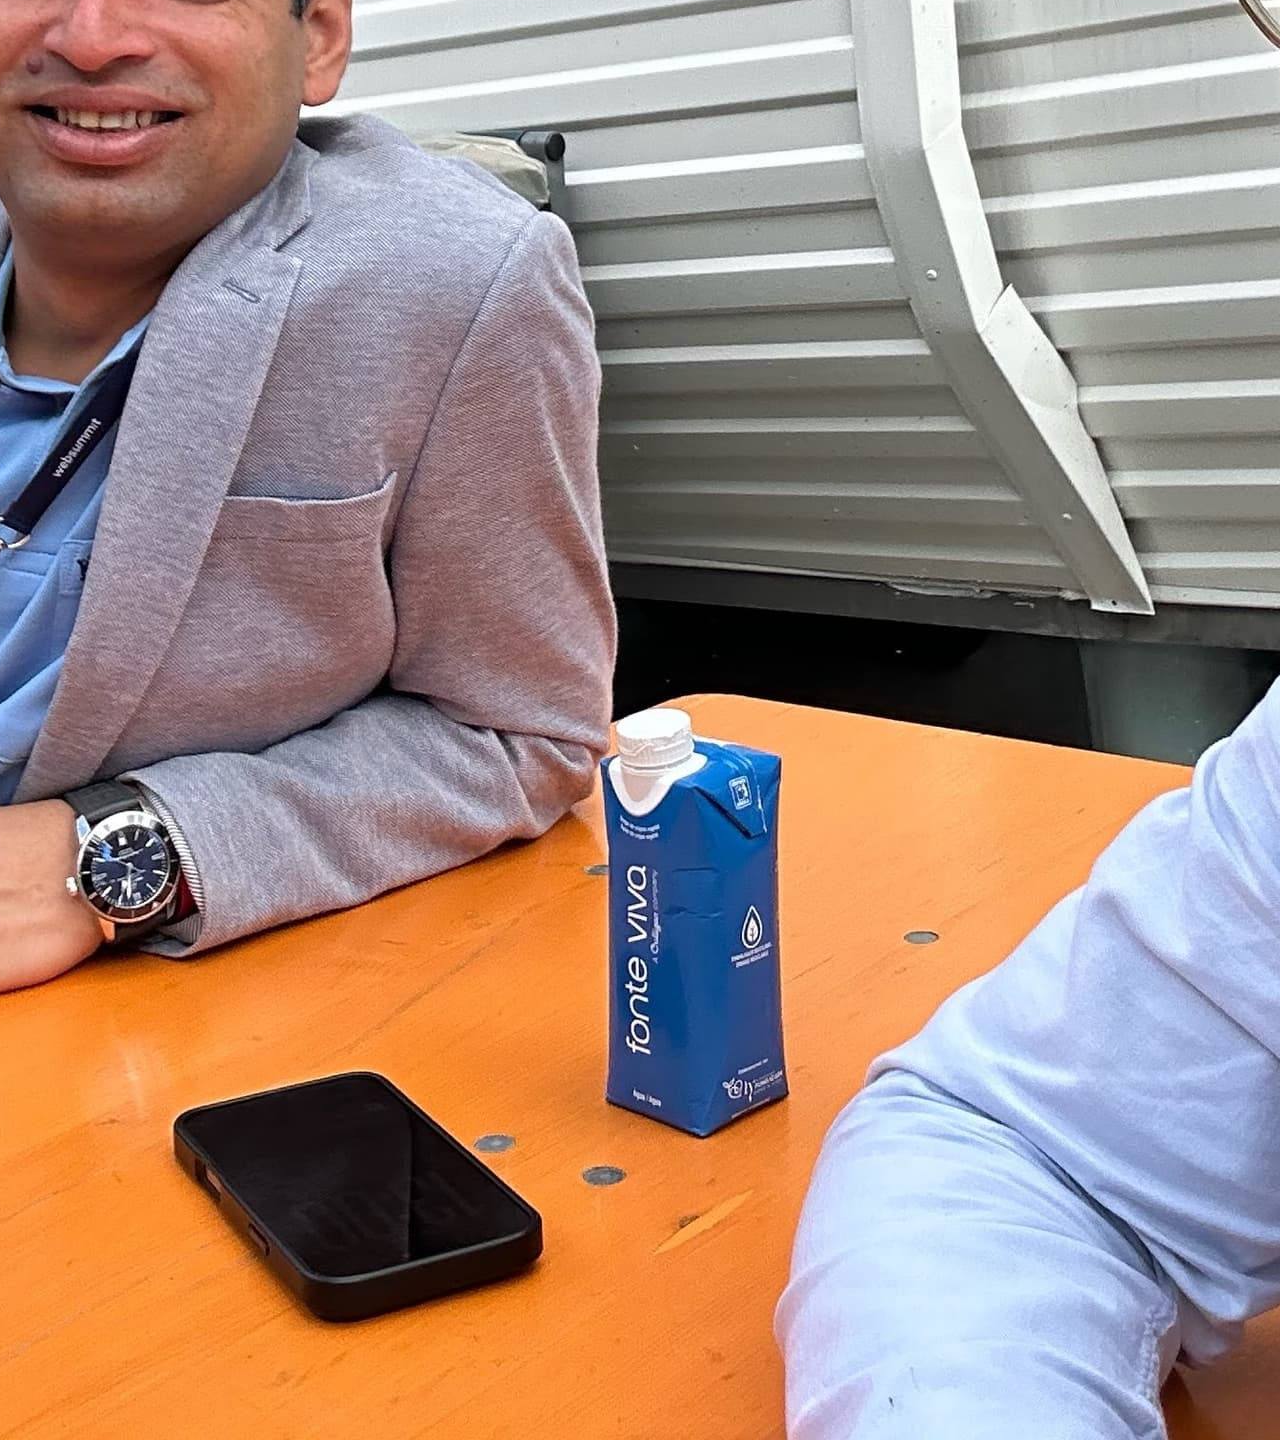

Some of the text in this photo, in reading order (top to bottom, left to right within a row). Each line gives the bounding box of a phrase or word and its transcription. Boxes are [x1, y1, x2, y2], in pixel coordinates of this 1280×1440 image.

[52, 418, 102, 479] websummit
[627, 865, 648, 943] viva
[625, 956, 651, 1055] fonte
